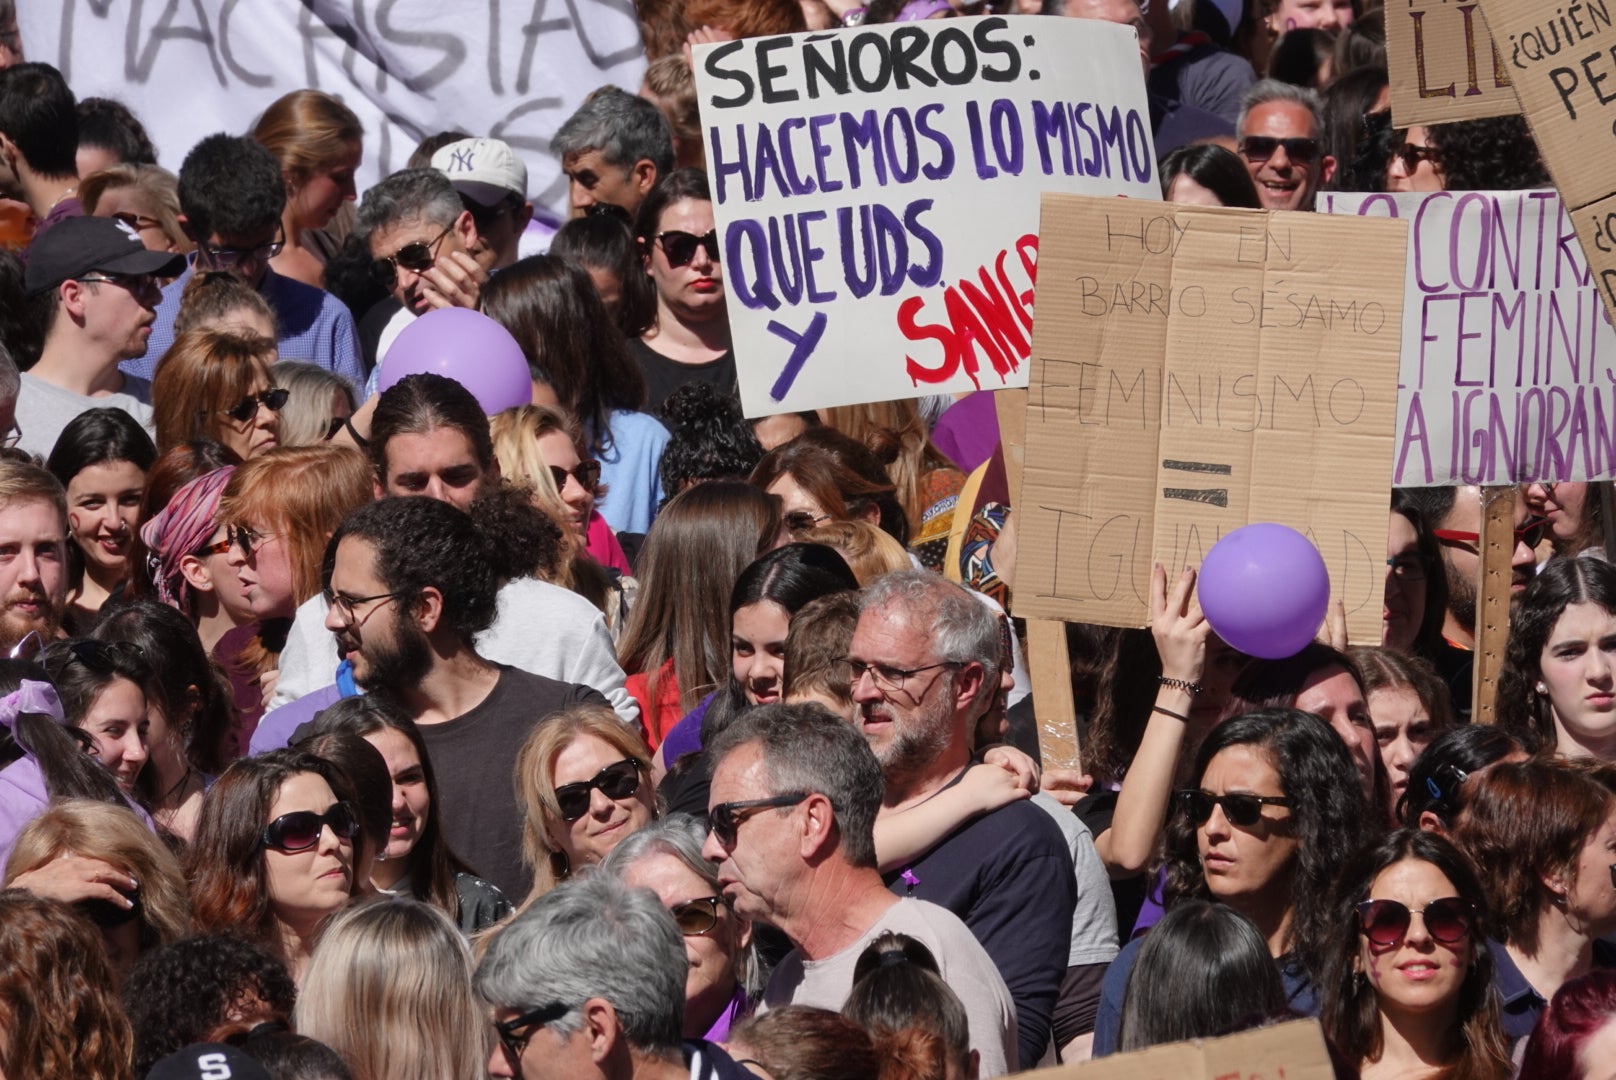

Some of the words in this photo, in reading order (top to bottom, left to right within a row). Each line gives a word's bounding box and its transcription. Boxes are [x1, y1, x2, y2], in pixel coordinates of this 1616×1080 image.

[704, 17, 1041, 108] SEÑOROS:
[1408, 4, 1513, 99] LI
[1548, 44, 1616, 121] PE
[709, 102, 956, 205] HACEMOS
[966, 98, 1024, 180] LO
[1031, 99, 1151, 184] MISMO
[725, 209, 838, 311] QUE
[1105, 214, 1191, 257] HOY
[1237, 226, 1292, 263] EN
[1413, 191, 1591, 293] CONTR
[1075, 276, 1207, 319] BARRIO
[1230, 279, 1386, 335] SÉSAMO
[766, 311, 828, 402] Y
[1039, 357, 1366, 432] FEMINISMO
[197, 1052, 232, 1080] S
